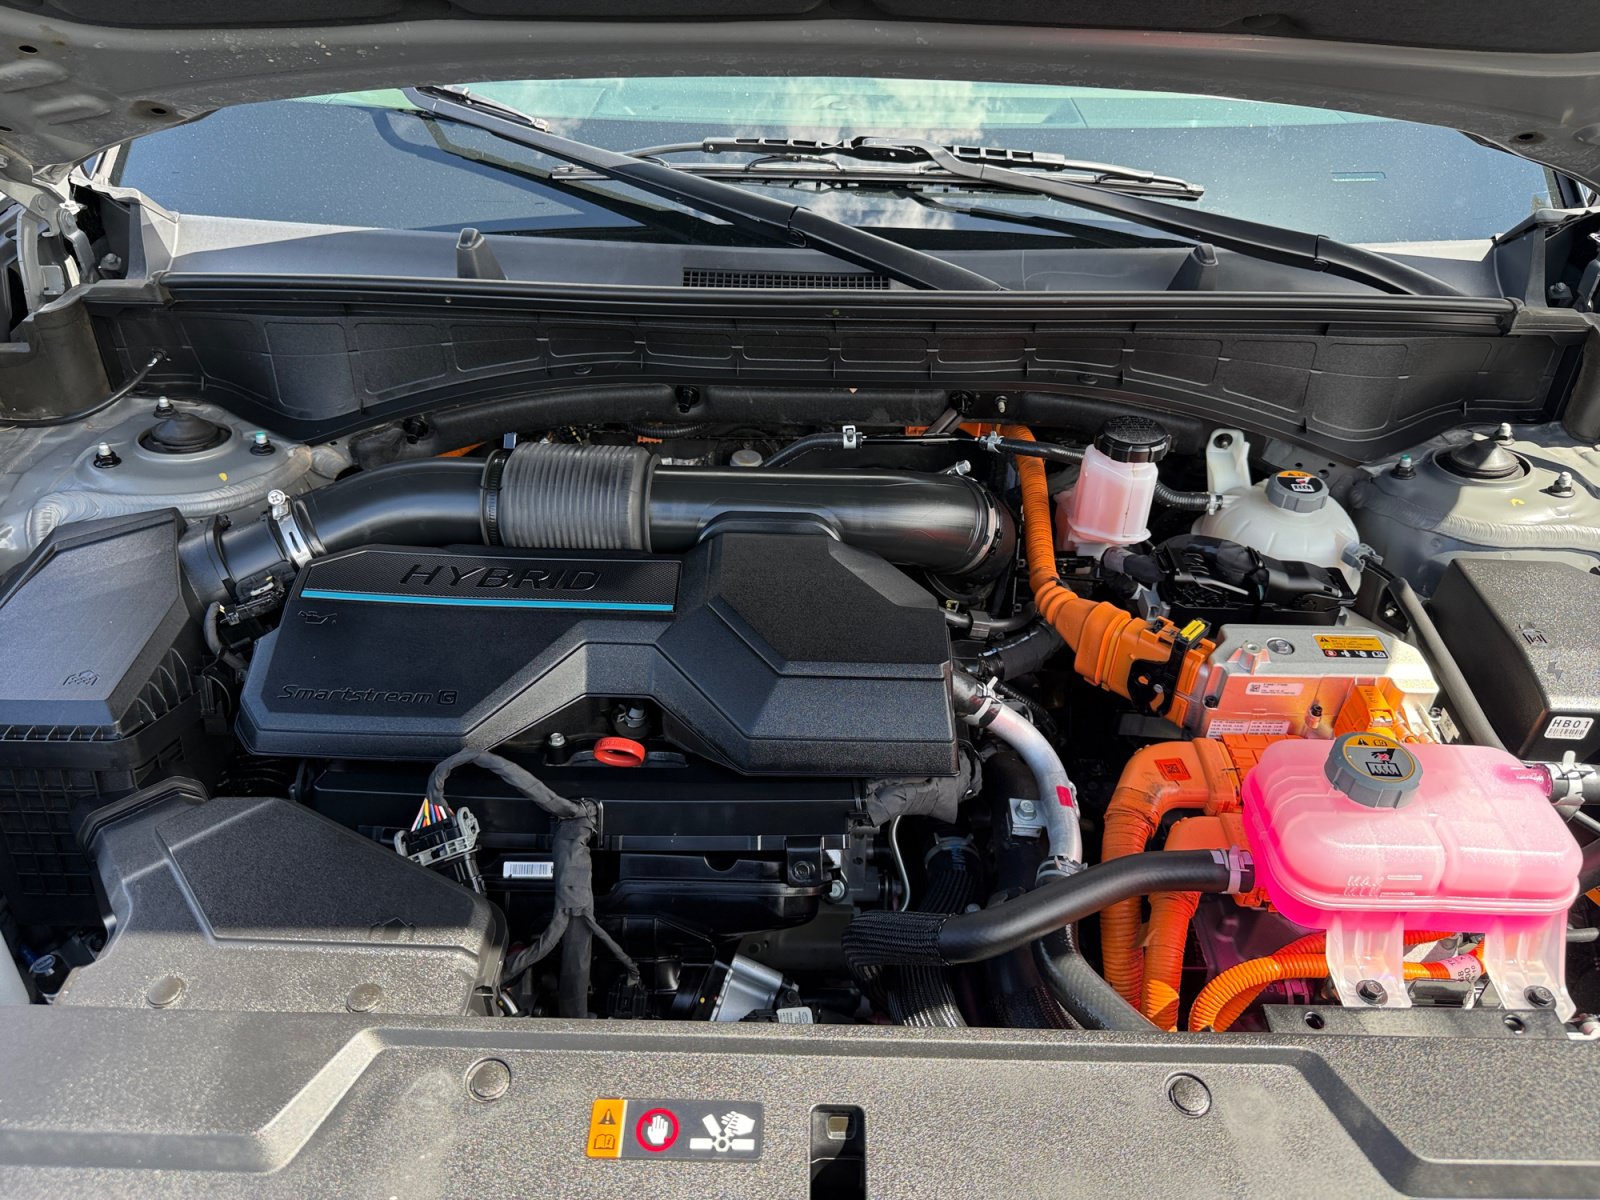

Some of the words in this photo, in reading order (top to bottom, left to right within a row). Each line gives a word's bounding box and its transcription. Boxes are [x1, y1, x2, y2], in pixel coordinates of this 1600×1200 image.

[399, 564, 601, 591] HYBRID
[277, 684, 434, 704] Smartstream
[1551, 719, 1590, 729] HB01
